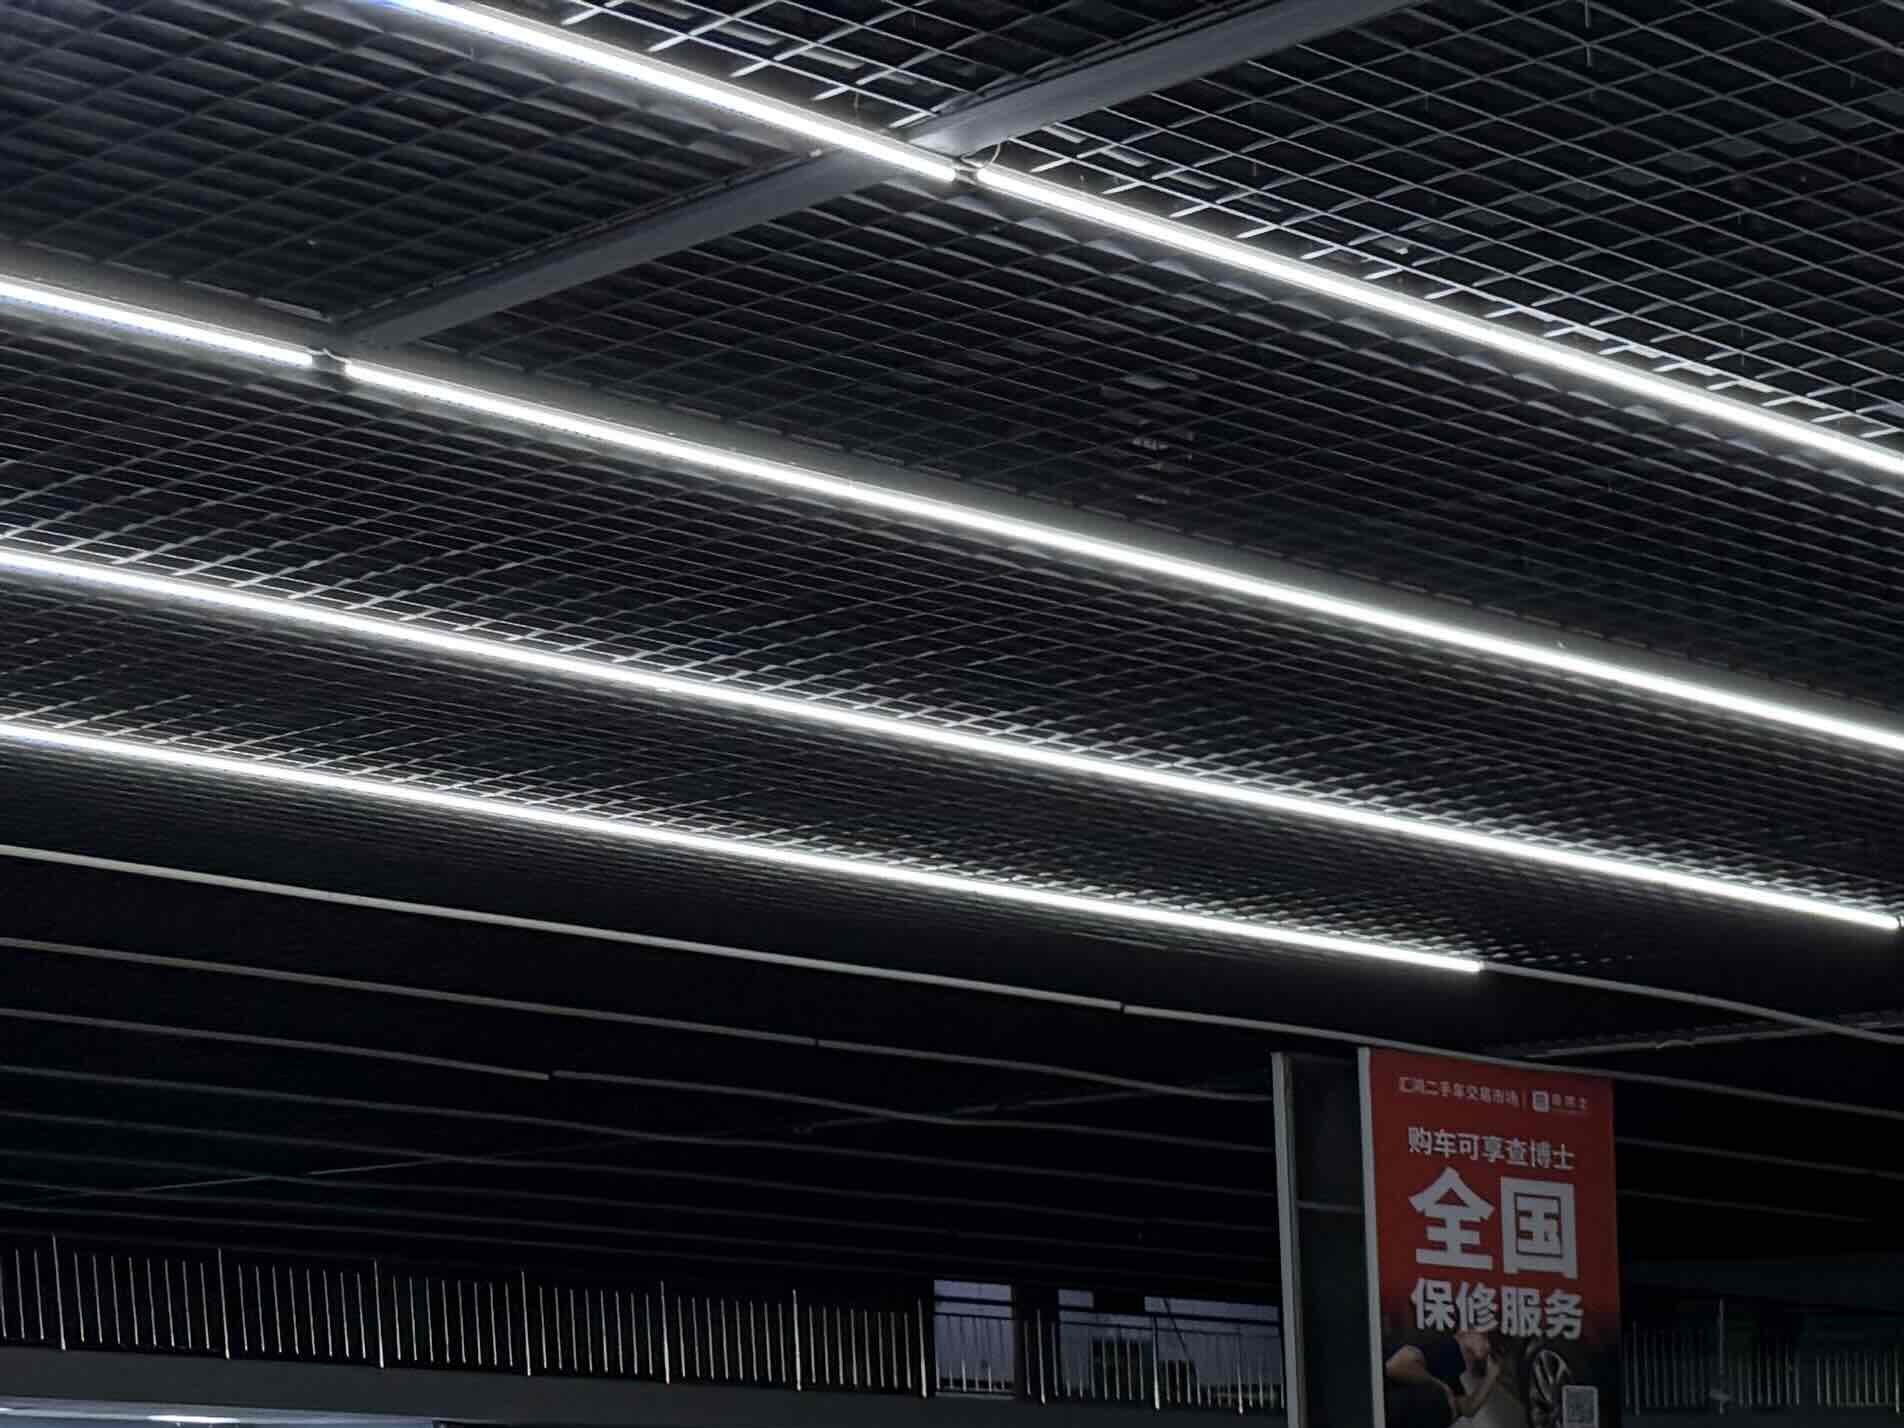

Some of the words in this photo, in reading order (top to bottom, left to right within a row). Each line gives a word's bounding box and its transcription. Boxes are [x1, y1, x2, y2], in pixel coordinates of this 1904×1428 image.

[1407, 1125, 1576, 1170] 购车可享查博士
[1408, 1166, 1579, 1281] 全国
[1411, 1277, 1585, 1340] 保修服务
